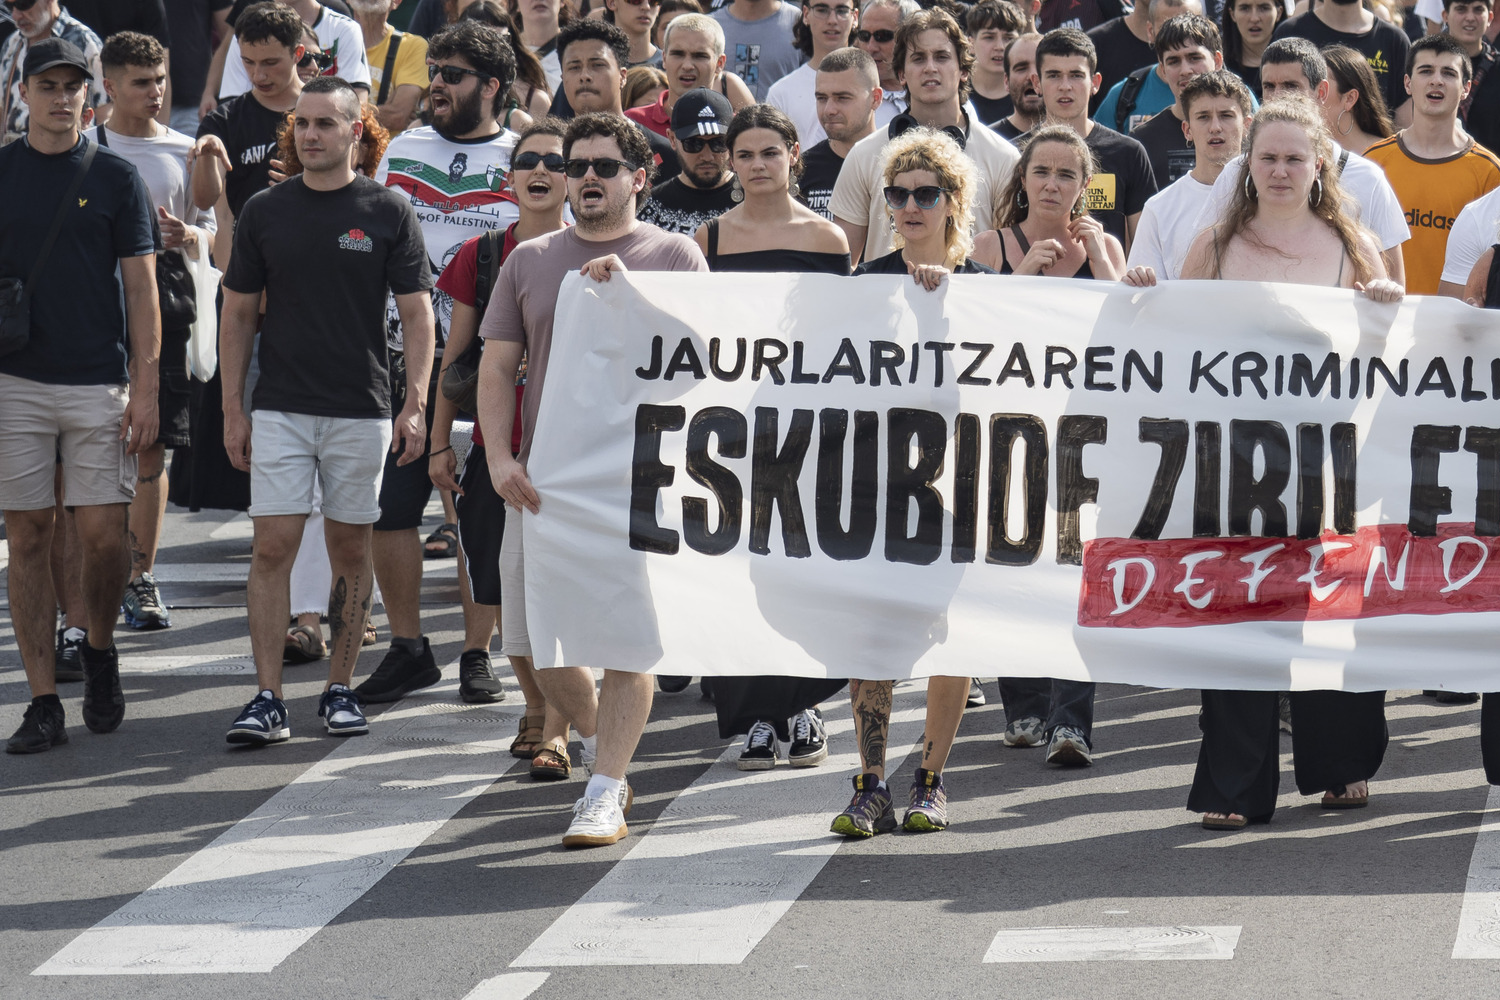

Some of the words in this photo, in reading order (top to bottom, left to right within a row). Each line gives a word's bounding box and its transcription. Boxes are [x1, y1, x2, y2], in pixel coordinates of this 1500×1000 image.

[426, 213, 442, 223] OF
[444, 215, 498, 230] PALESTINE
[1404, 208, 1456, 231] didas
[635, 334, 1163, 393] JAURLARITZAREN
[628, 403, 1108, 566] ESKUBIDE
